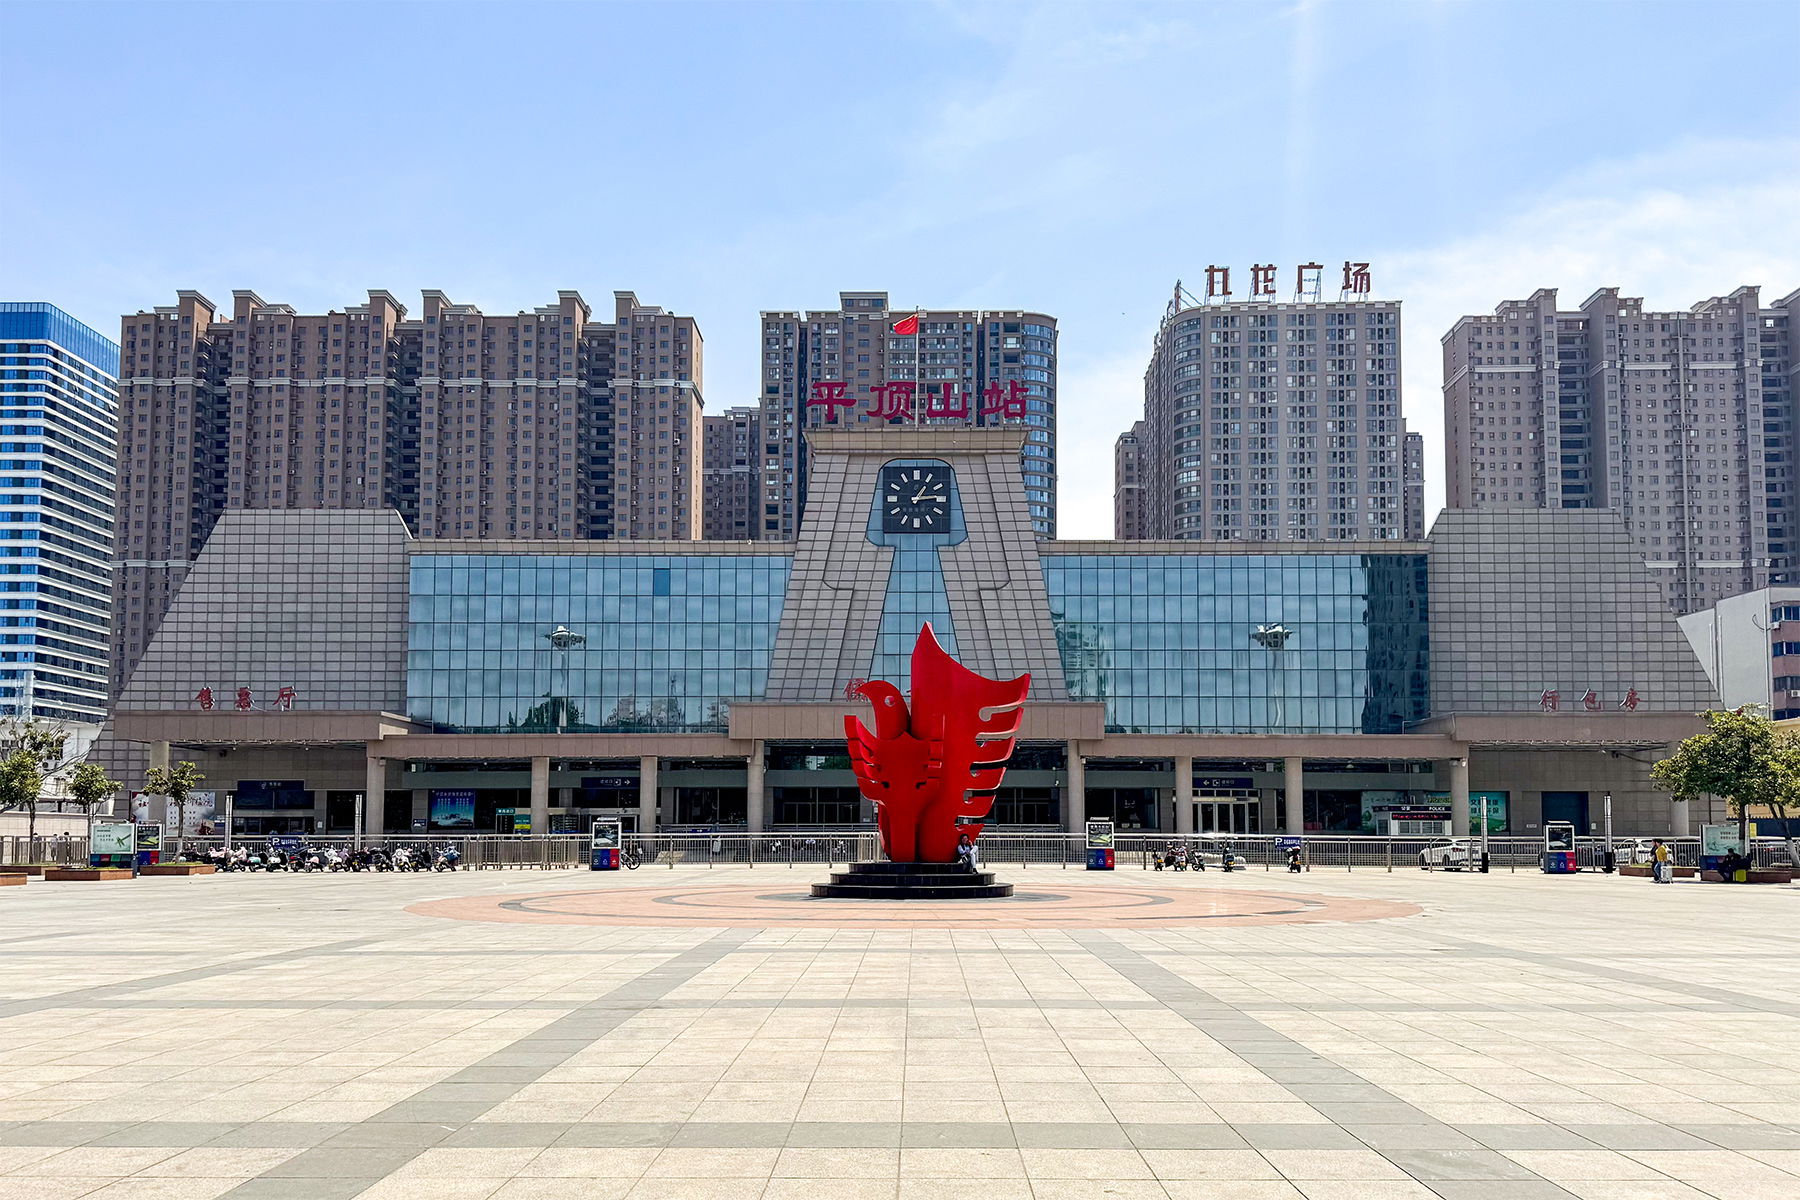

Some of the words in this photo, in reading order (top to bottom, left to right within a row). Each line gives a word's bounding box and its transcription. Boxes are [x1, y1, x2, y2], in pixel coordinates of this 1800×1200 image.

[1205, 261, 1370, 297] 九龙广场
[806, 380, 1029, 421] 平顶山站
[195, 686, 297, 711] 售票厅
[1539, 686, 1641, 712] 行包房
[272, 837, 280, 846] P
[1275, 837, 1283, 846] P
